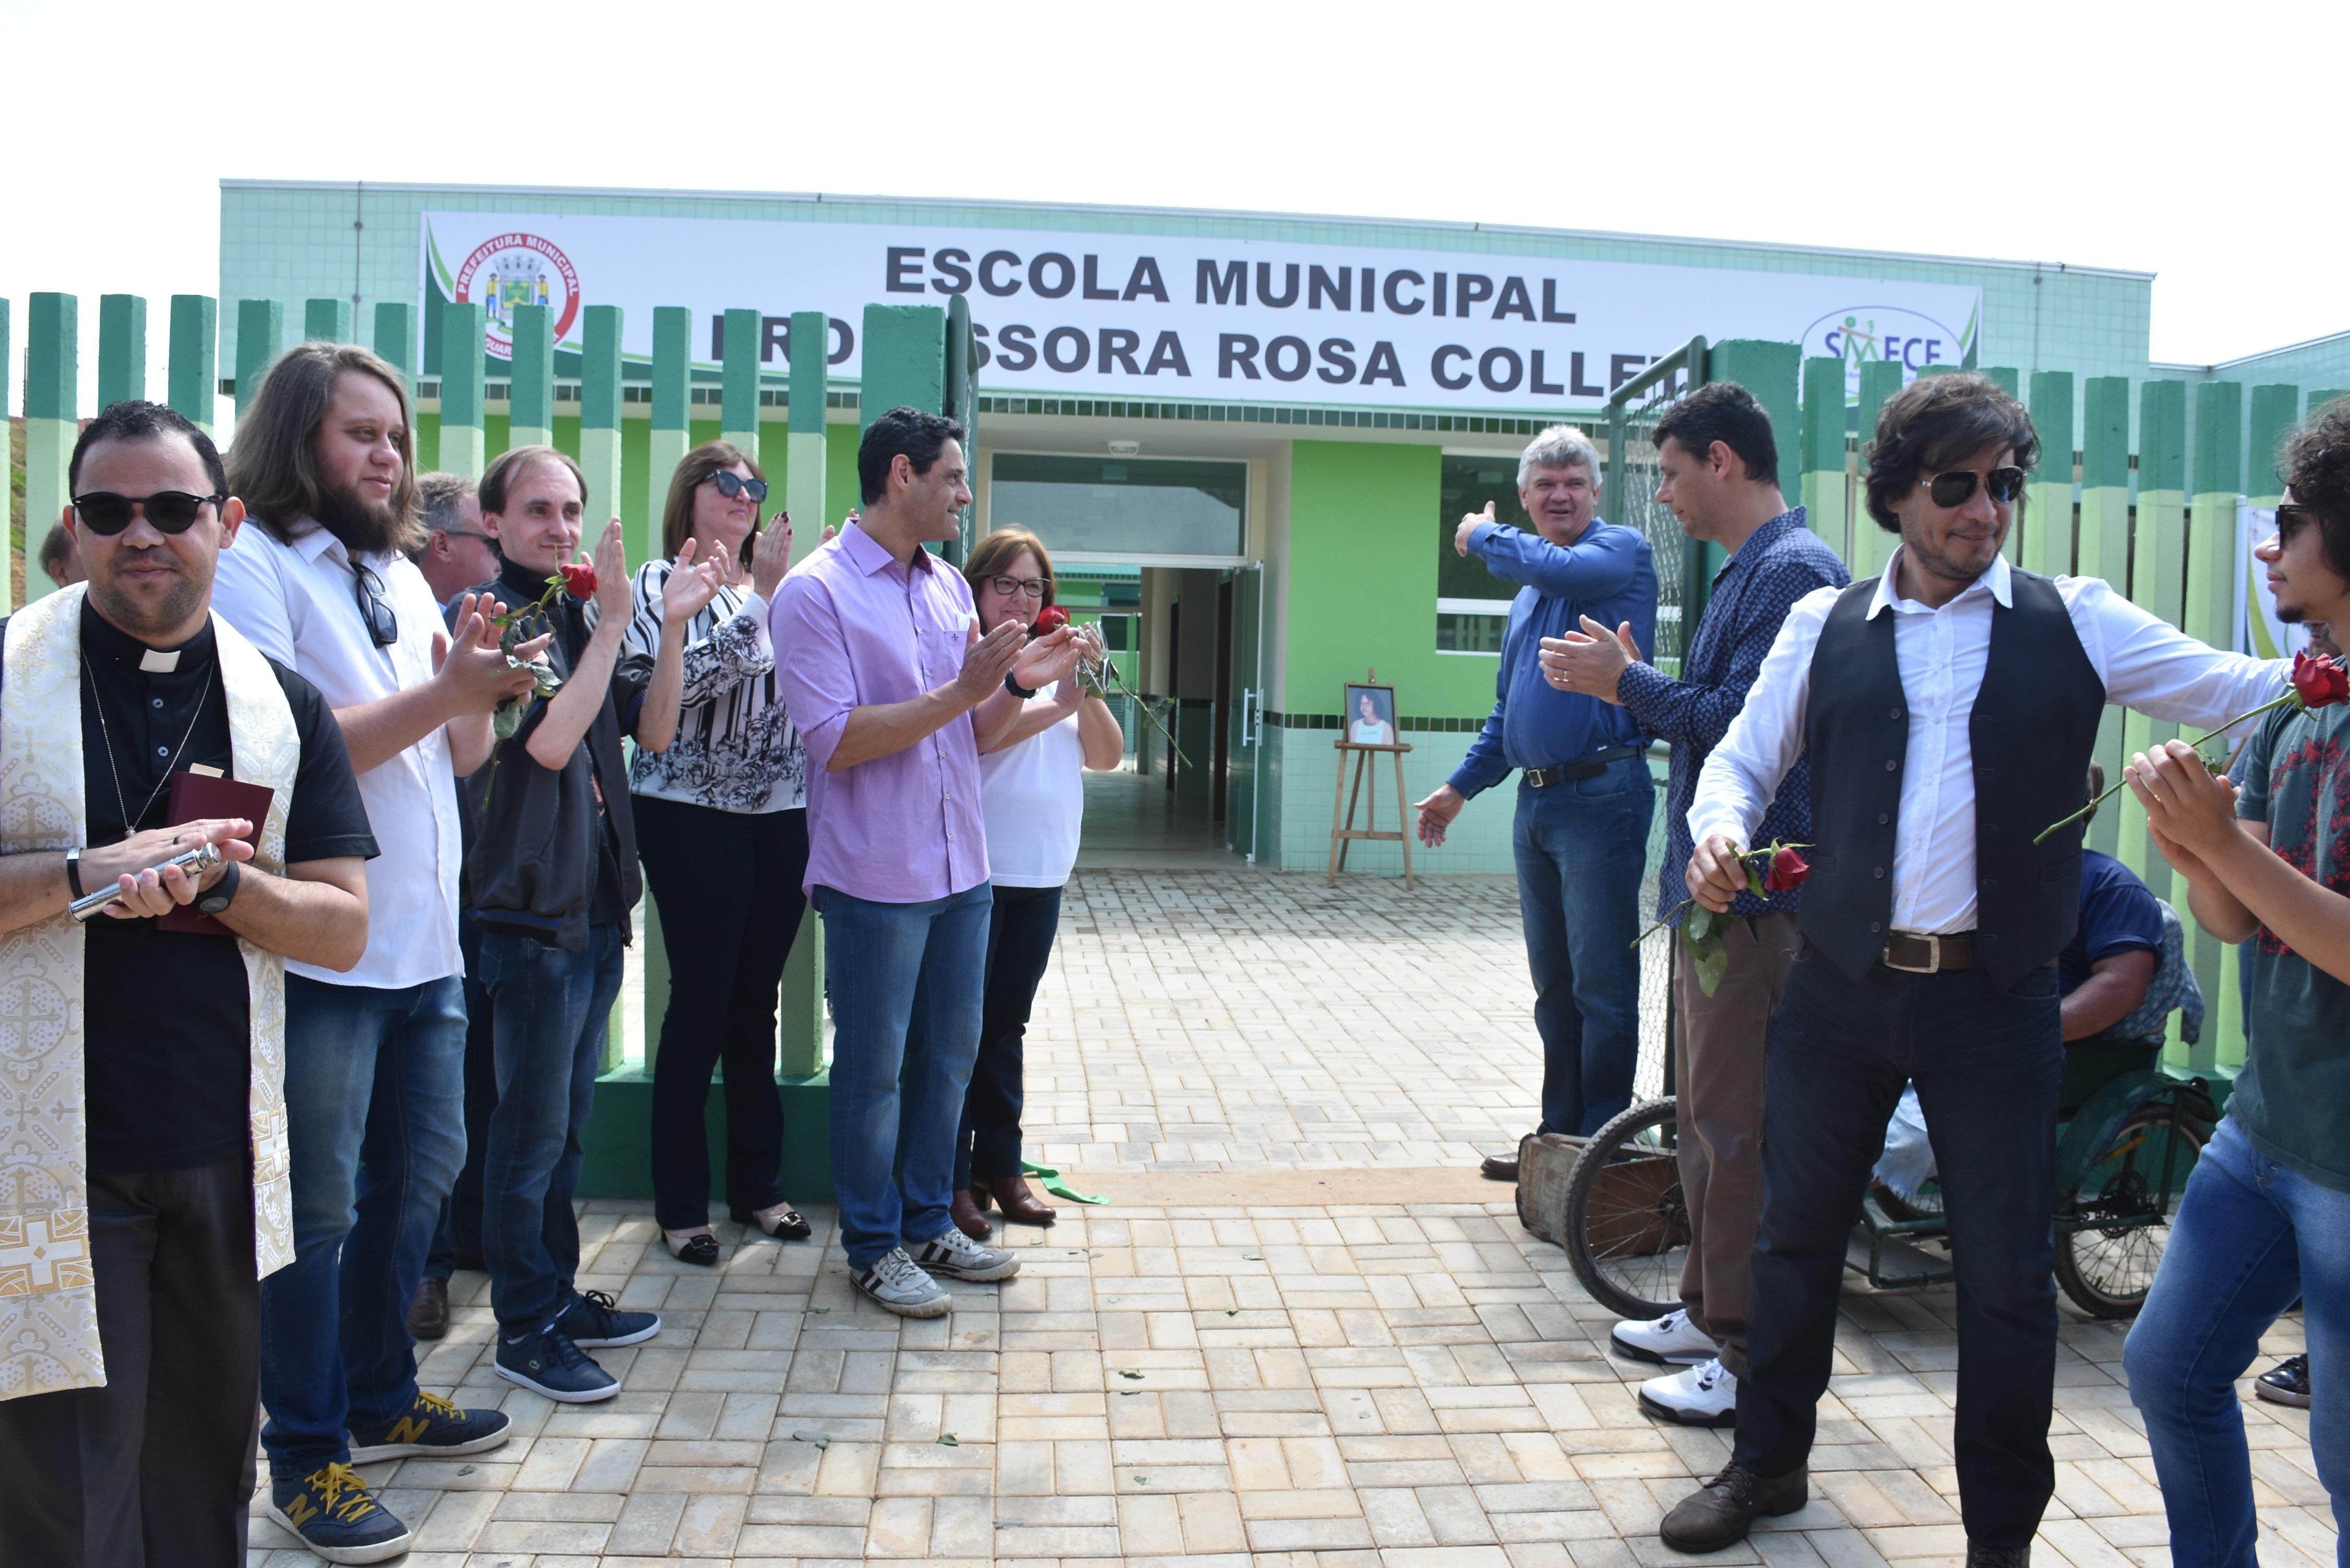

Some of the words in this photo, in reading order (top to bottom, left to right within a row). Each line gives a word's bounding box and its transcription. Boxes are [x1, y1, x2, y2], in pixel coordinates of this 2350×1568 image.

[457, 234, 523, 294] PREFEITURA
[526, 235, 578, 297] MUNICIPAL
[886, 247, 1170, 303] ESCOLA
[1195, 260, 1576, 324] MUNICIPAL
[1218, 333, 1406, 387] ROSA
[385, 1416, 431, 1444] N
[284, 1492, 318, 1528] N
